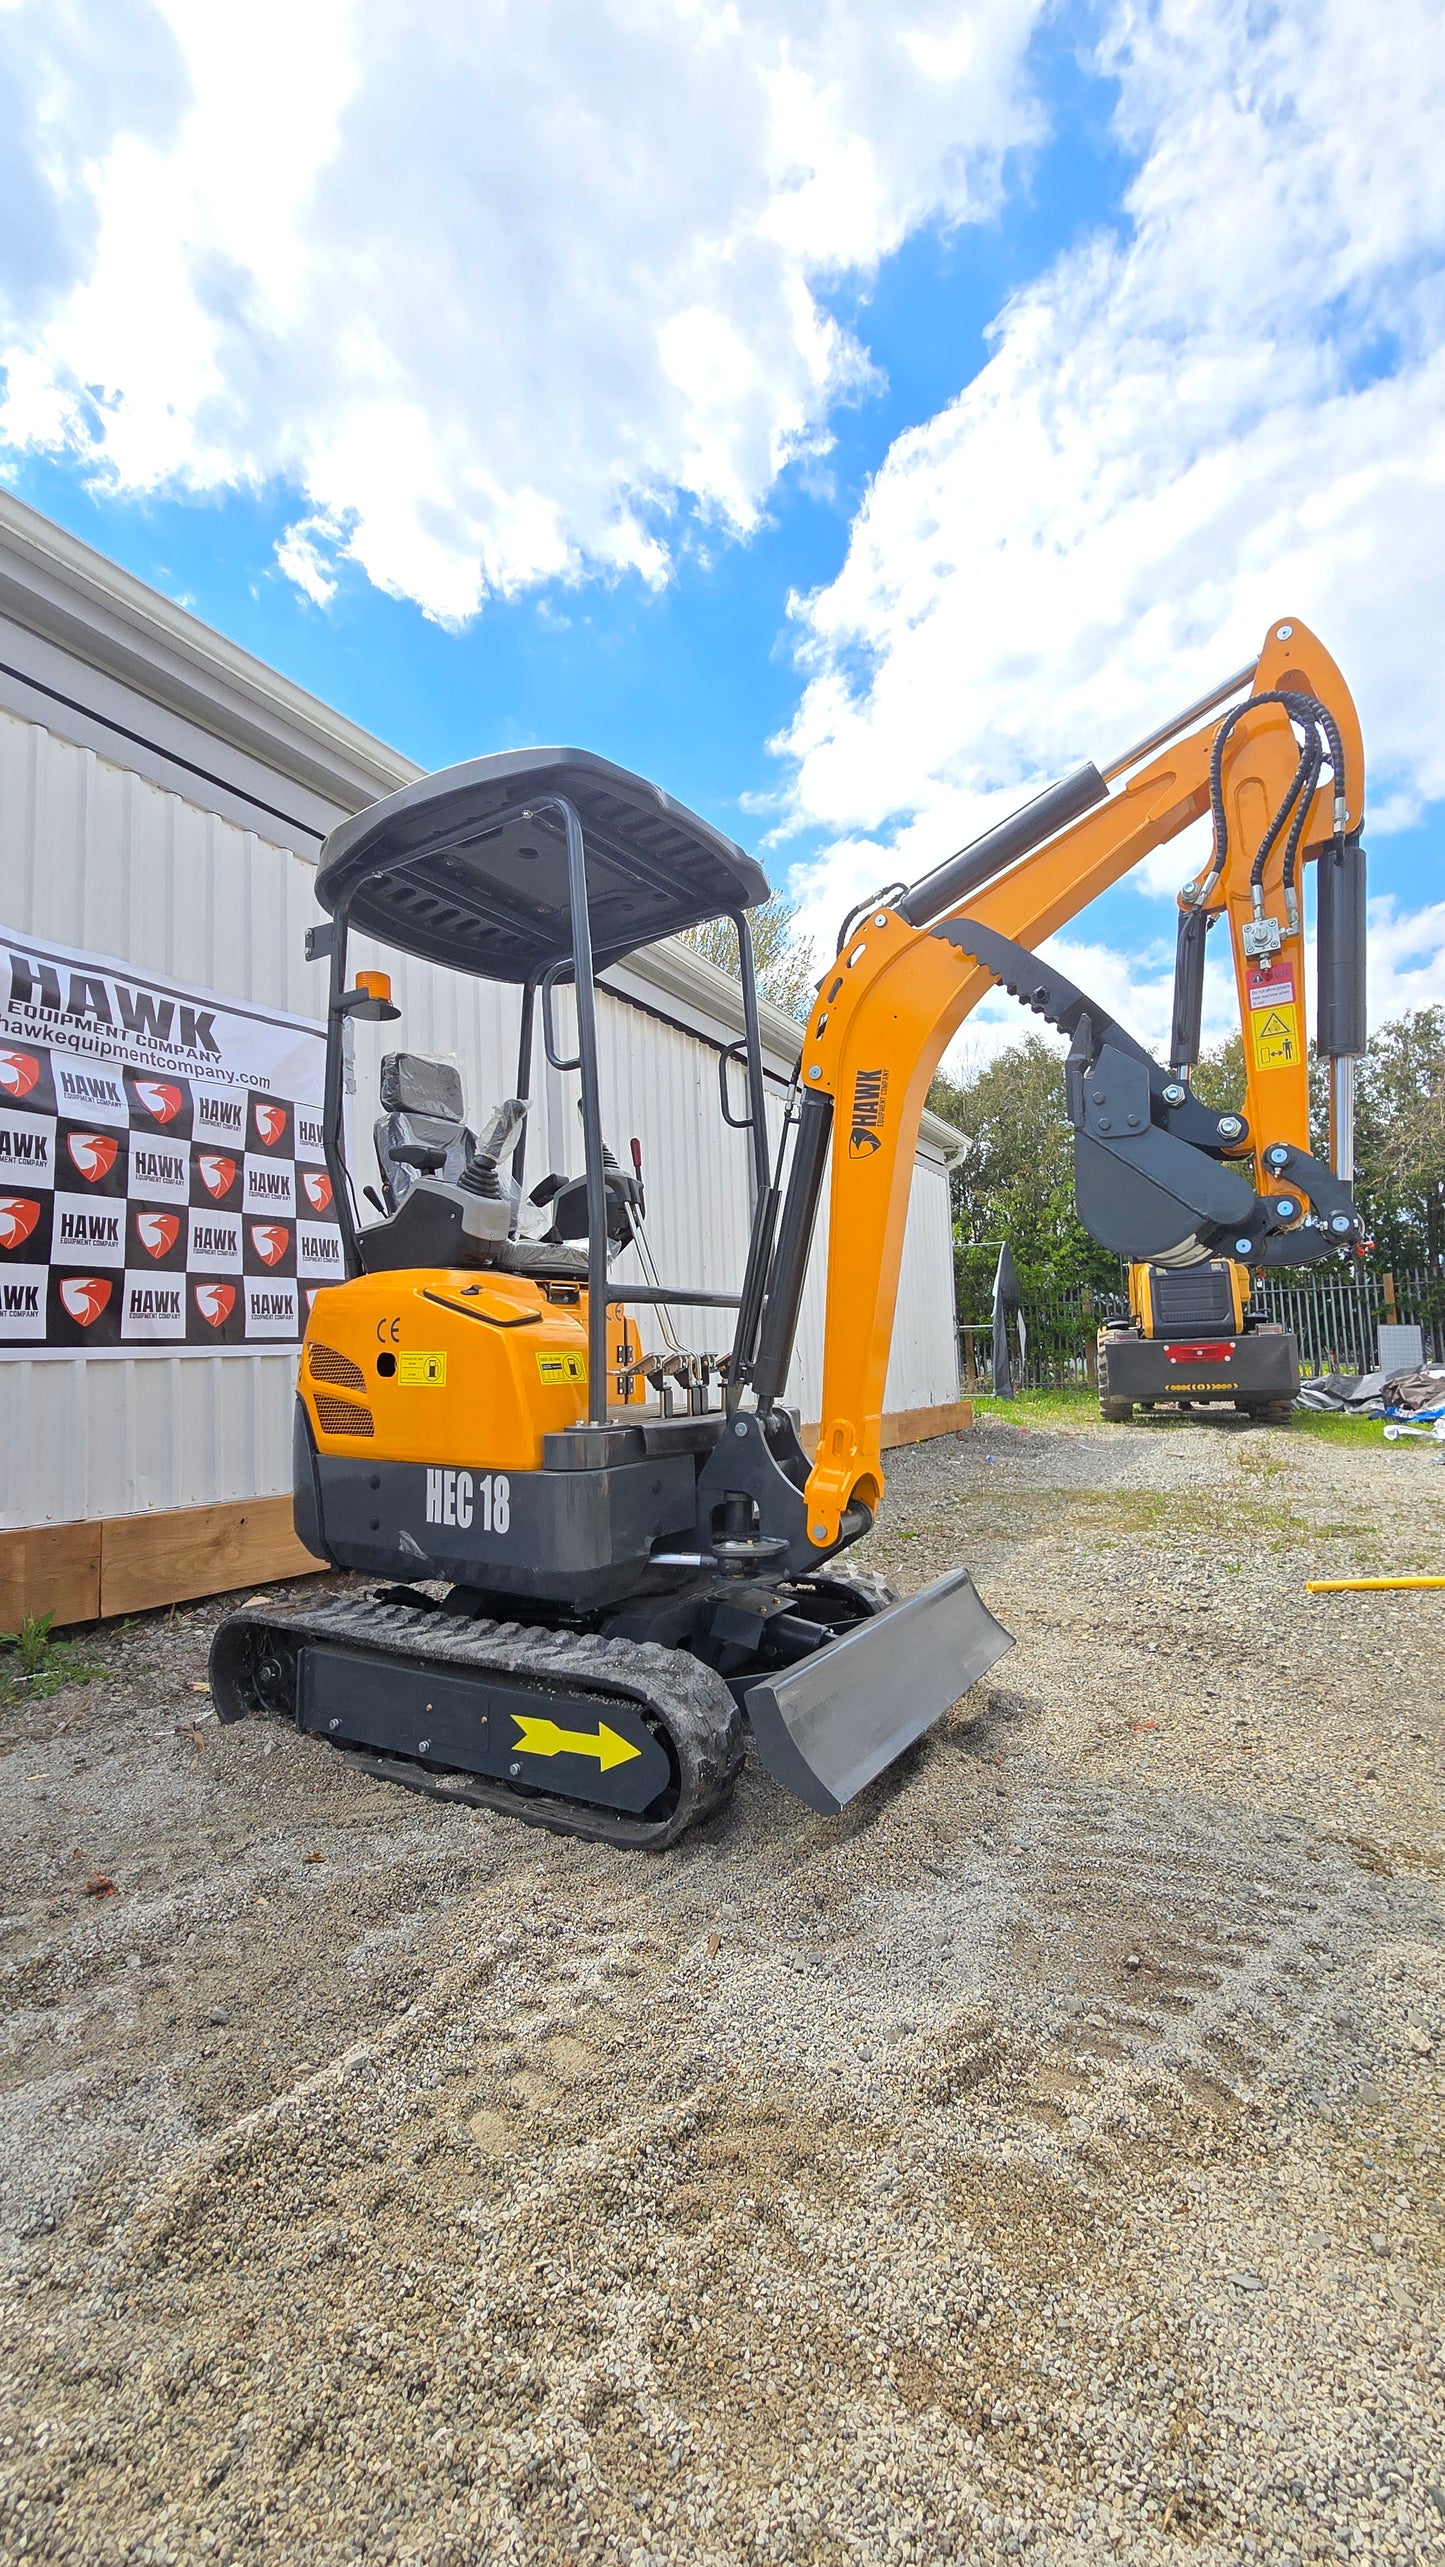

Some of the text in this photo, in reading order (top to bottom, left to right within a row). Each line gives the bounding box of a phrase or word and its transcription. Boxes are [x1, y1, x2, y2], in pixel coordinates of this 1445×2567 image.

[9, 954, 221, 1054] HAWK
[8, 1000, 222, 1064] EQUIPMENT COMPANY
[59, 1071, 122, 1103] HAWK
[63, 1092, 122, 1108] EQUIPMENT COMPANY
[851, 1069, 882, 1127] HAWK
[877, 1069, 889, 1127] EQUIPMENT COMPANY
[199, 1097, 242, 1126] HAWK
[0, 1130, 48, 1161] AWK
[18, 1158, 48, 1168] COMPANY
[135, 1151, 184, 1180] HAWK
[135, 1173, 185, 1186] EQUIPMENT COMPANY
[248, 1170, 291, 1195] HAWK
[61, 1213, 119, 1241] HAWK
[193, 1226, 238, 1251] HAWK
[60, 1237, 119, 1248] EQUIPMENT COMPANY
[301, 1236, 340, 1258] HAWK
[9, 1310, 39, 1318] COMPANY
[129, 1289, 181, 1313] HAWK
[250, 1293, 294, 1315] HAWK
[129, 1312, 158, 1320] EQUIPMENT
[376, 1316, 400, 1344] CE
[426, 1468, 510, 1535] HEC 18
